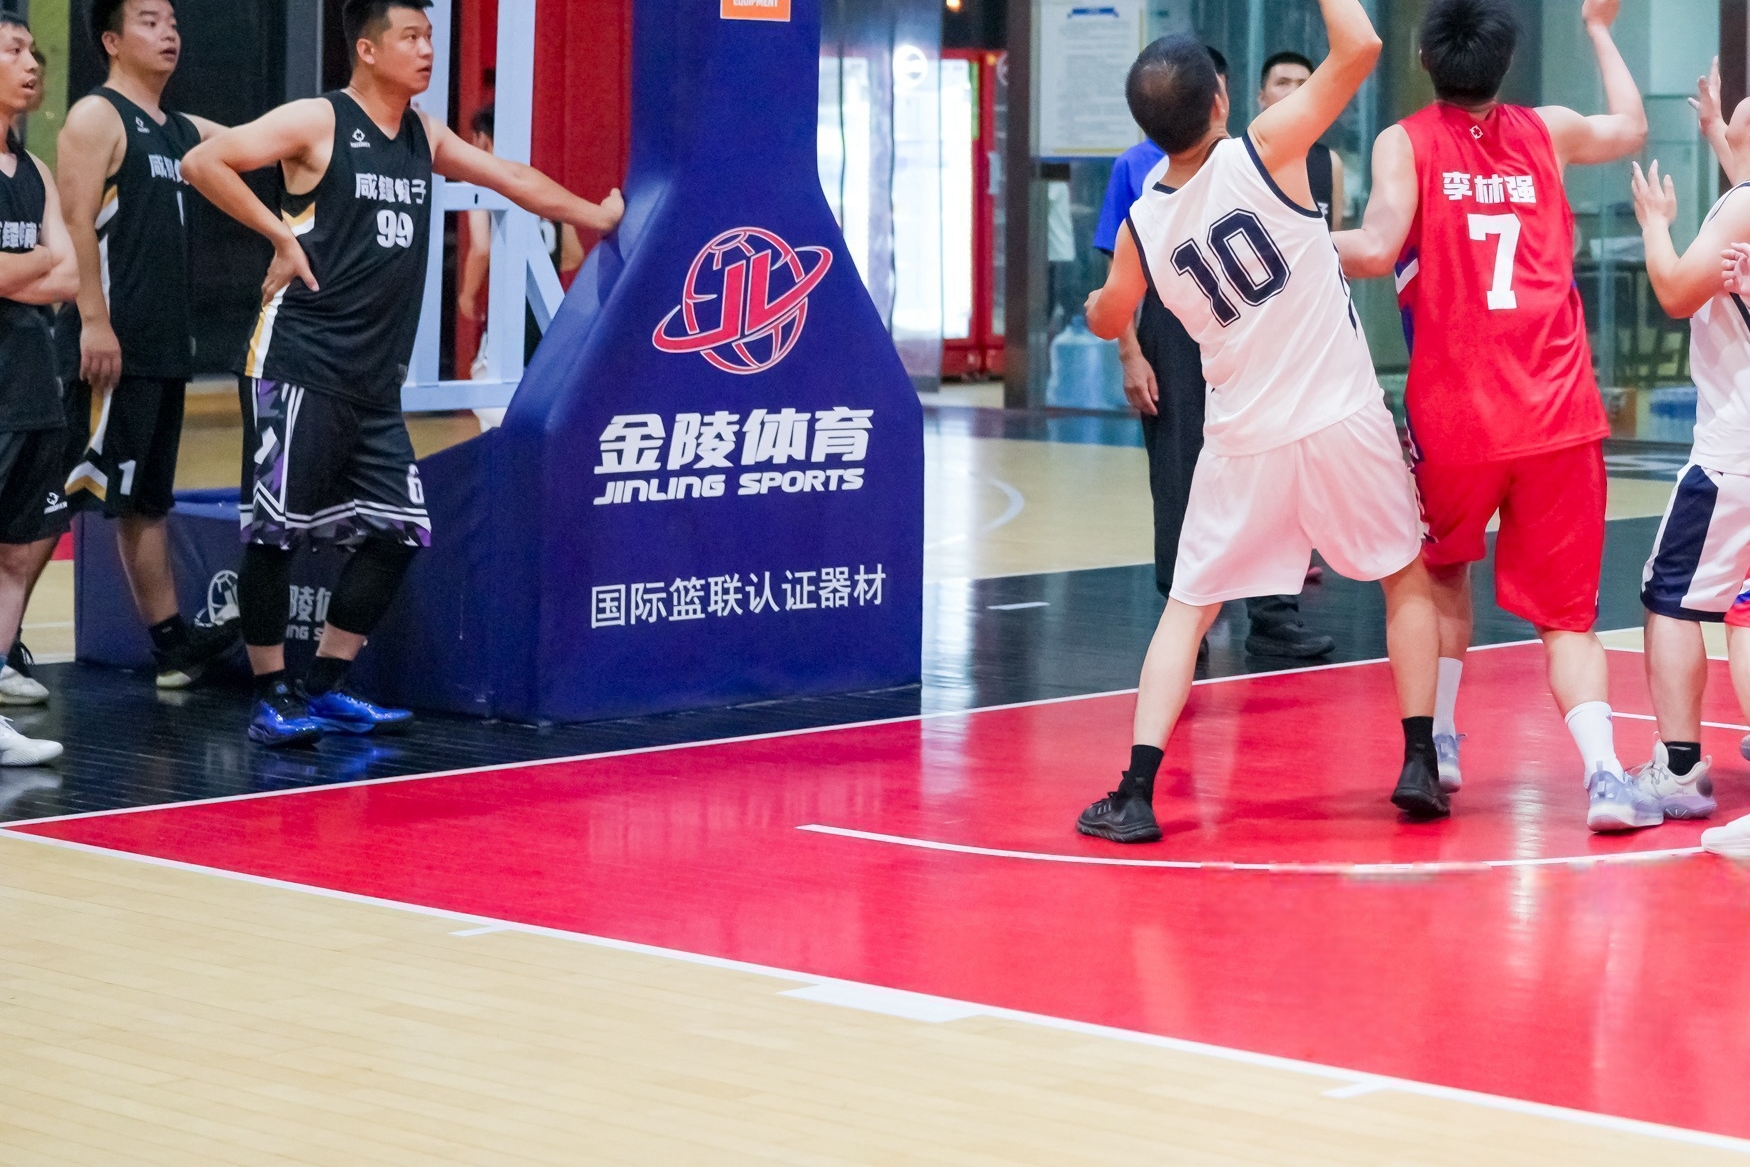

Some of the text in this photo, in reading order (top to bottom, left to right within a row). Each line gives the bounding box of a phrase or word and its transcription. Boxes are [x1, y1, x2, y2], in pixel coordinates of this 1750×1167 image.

[1442, 171, 1537, 204] 李林强
[376, 209, 414, 249] 99
[1170, 208, 1291, 328] 10
[1467, 213, 1522, 311] 7
[594, 406, 874, 474] 金陵体育
[118, 459, 136, 496] 1
[593, 468, 865, 505] JINLING SPORTS
[591, 563, 887, 629] 国际篮联认证器材
